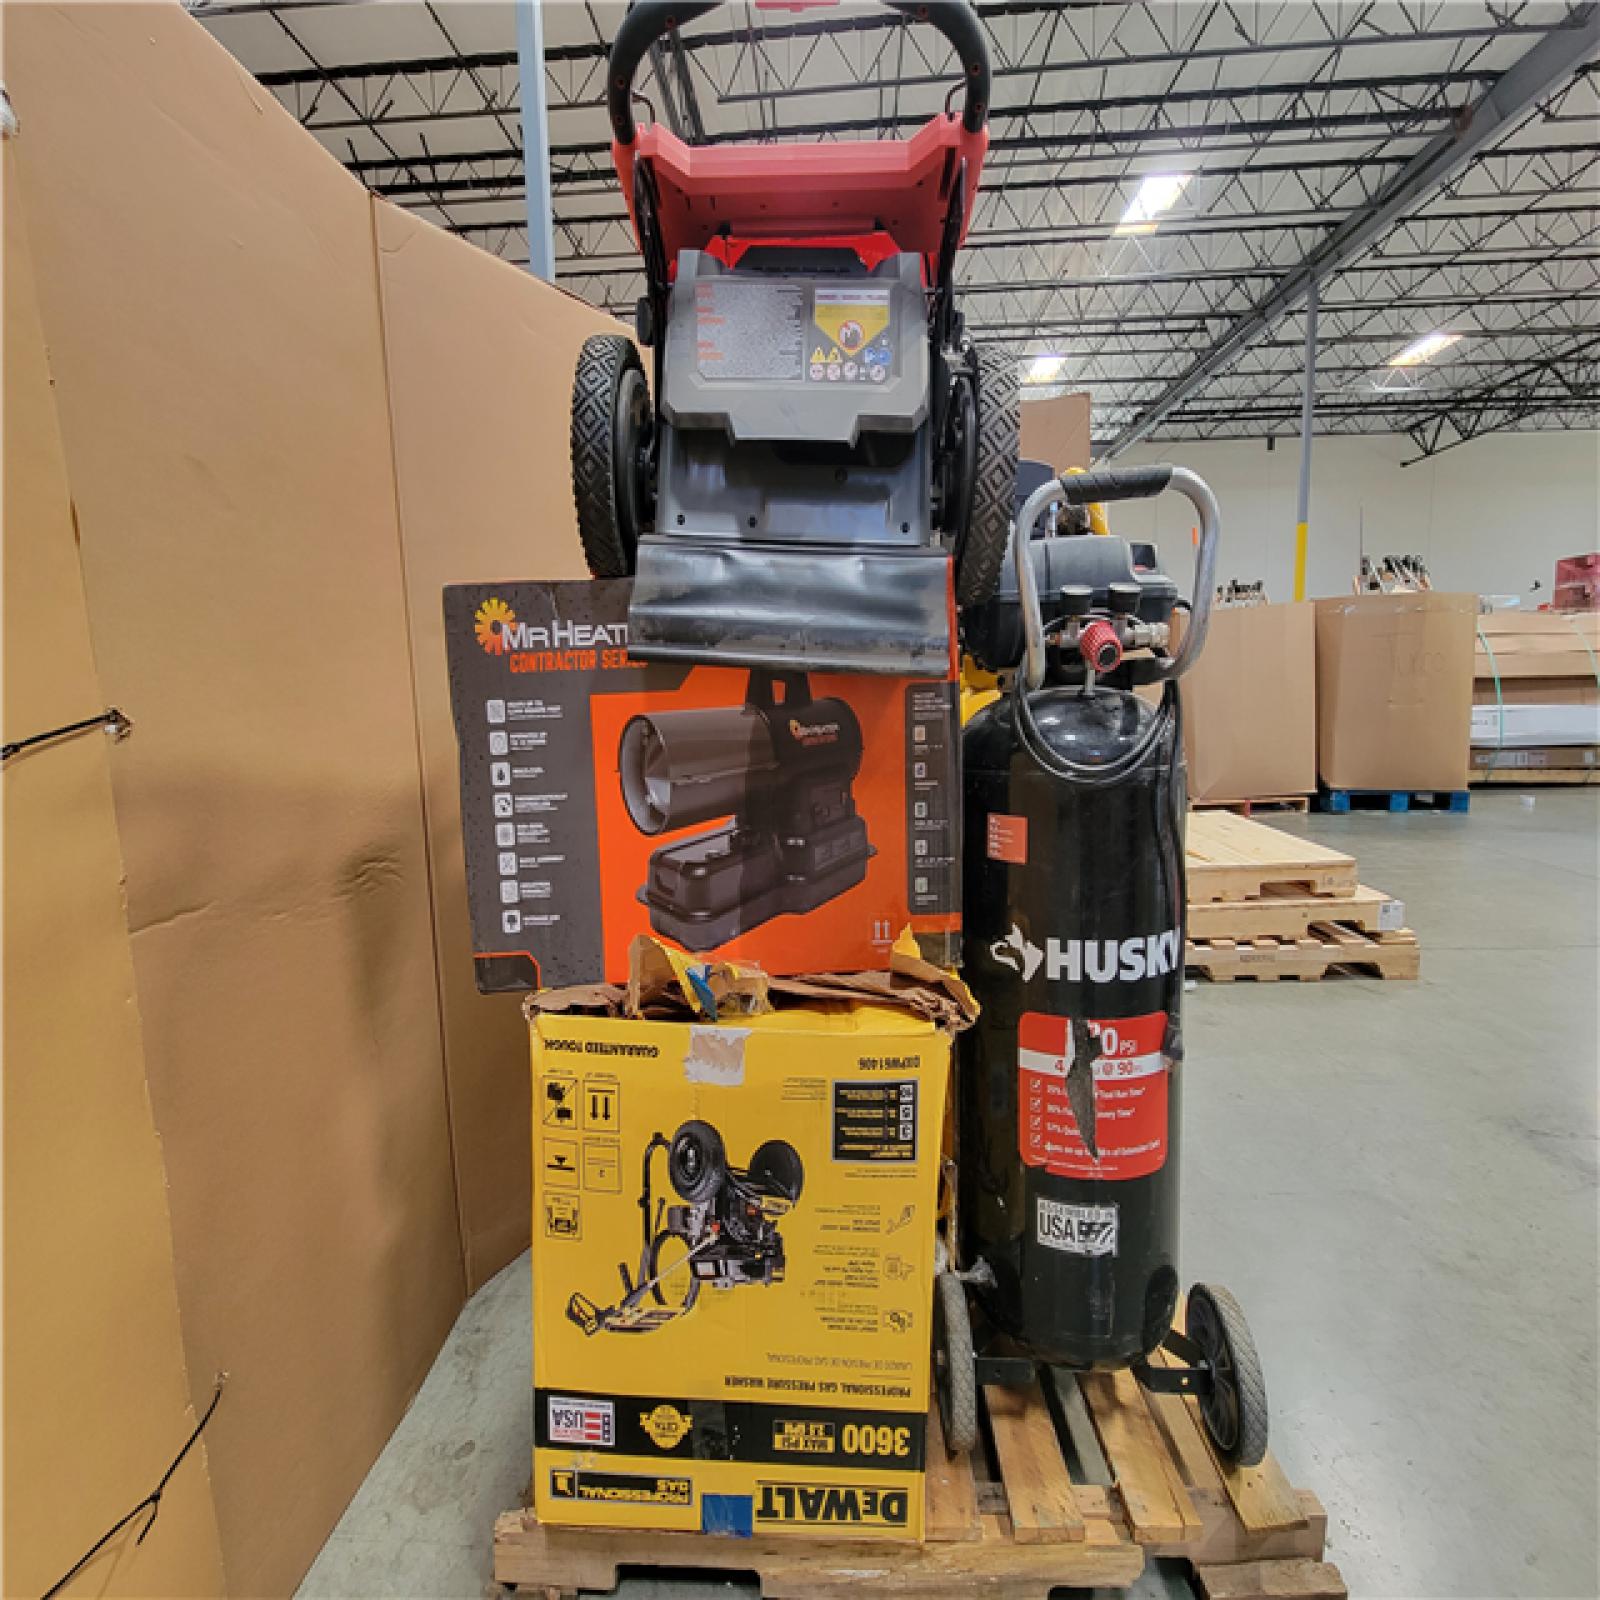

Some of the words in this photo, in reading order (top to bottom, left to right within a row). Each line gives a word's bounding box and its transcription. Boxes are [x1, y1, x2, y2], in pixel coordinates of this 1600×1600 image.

[552, 619, 628, 649] HEAT
[510, 650, 596, 672] CONTRACTOR
[1047, 927, 1180, 983] HUSKY
[585, 1042, 660, 1058] GUARANTEED
[1039, 1211, 1076, 1243] USA
[724, 1375, 764, 1388] WASHER
[767, 1377, 815, 1391] PRESSURE
[818, 1380, 838, 1391] GAS
[840, 1382, 911, 1398] PROFESSIONAL
[552, 1410, 582, 1428] USA
[843, 1424, 911, 1457] 3600
